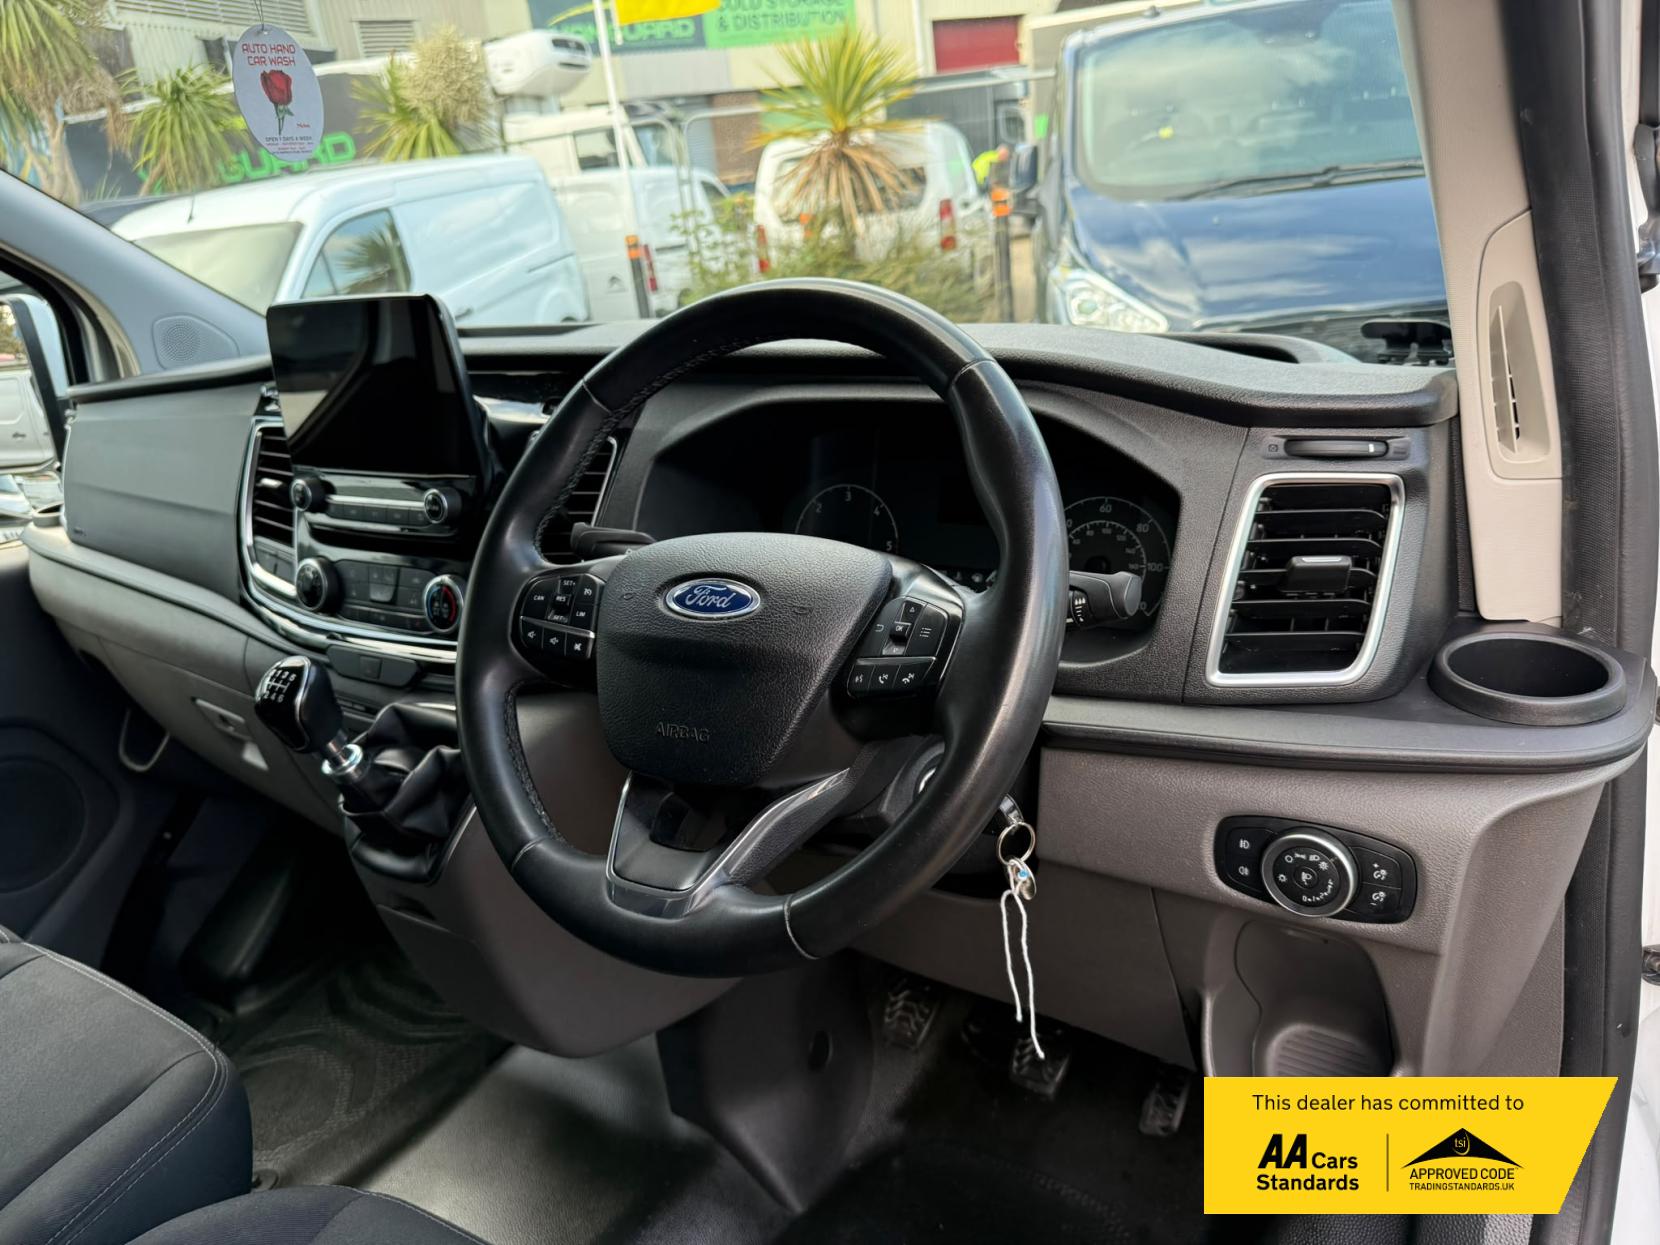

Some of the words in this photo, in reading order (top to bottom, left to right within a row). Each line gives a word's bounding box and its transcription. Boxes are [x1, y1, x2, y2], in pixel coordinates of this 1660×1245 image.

[241, 43, 268, 54] AUTO
[270, 44, 296, 54] HAND
[247, 56, 267, 66] CAR
[268, 56, 296, 66] WASH
[815, 503, 823, 514] 2
[873, 504, 881, 516] 4
[1099, 504, 1113, 514] 60
[1136, 523, 1150, 534] 80
[886, 540, 893, 551] 5
[1147, 562, 1164, 573] 100
[685, 585, 737, 609] Ford
[656, 721, 711, 742] AIRBAG
